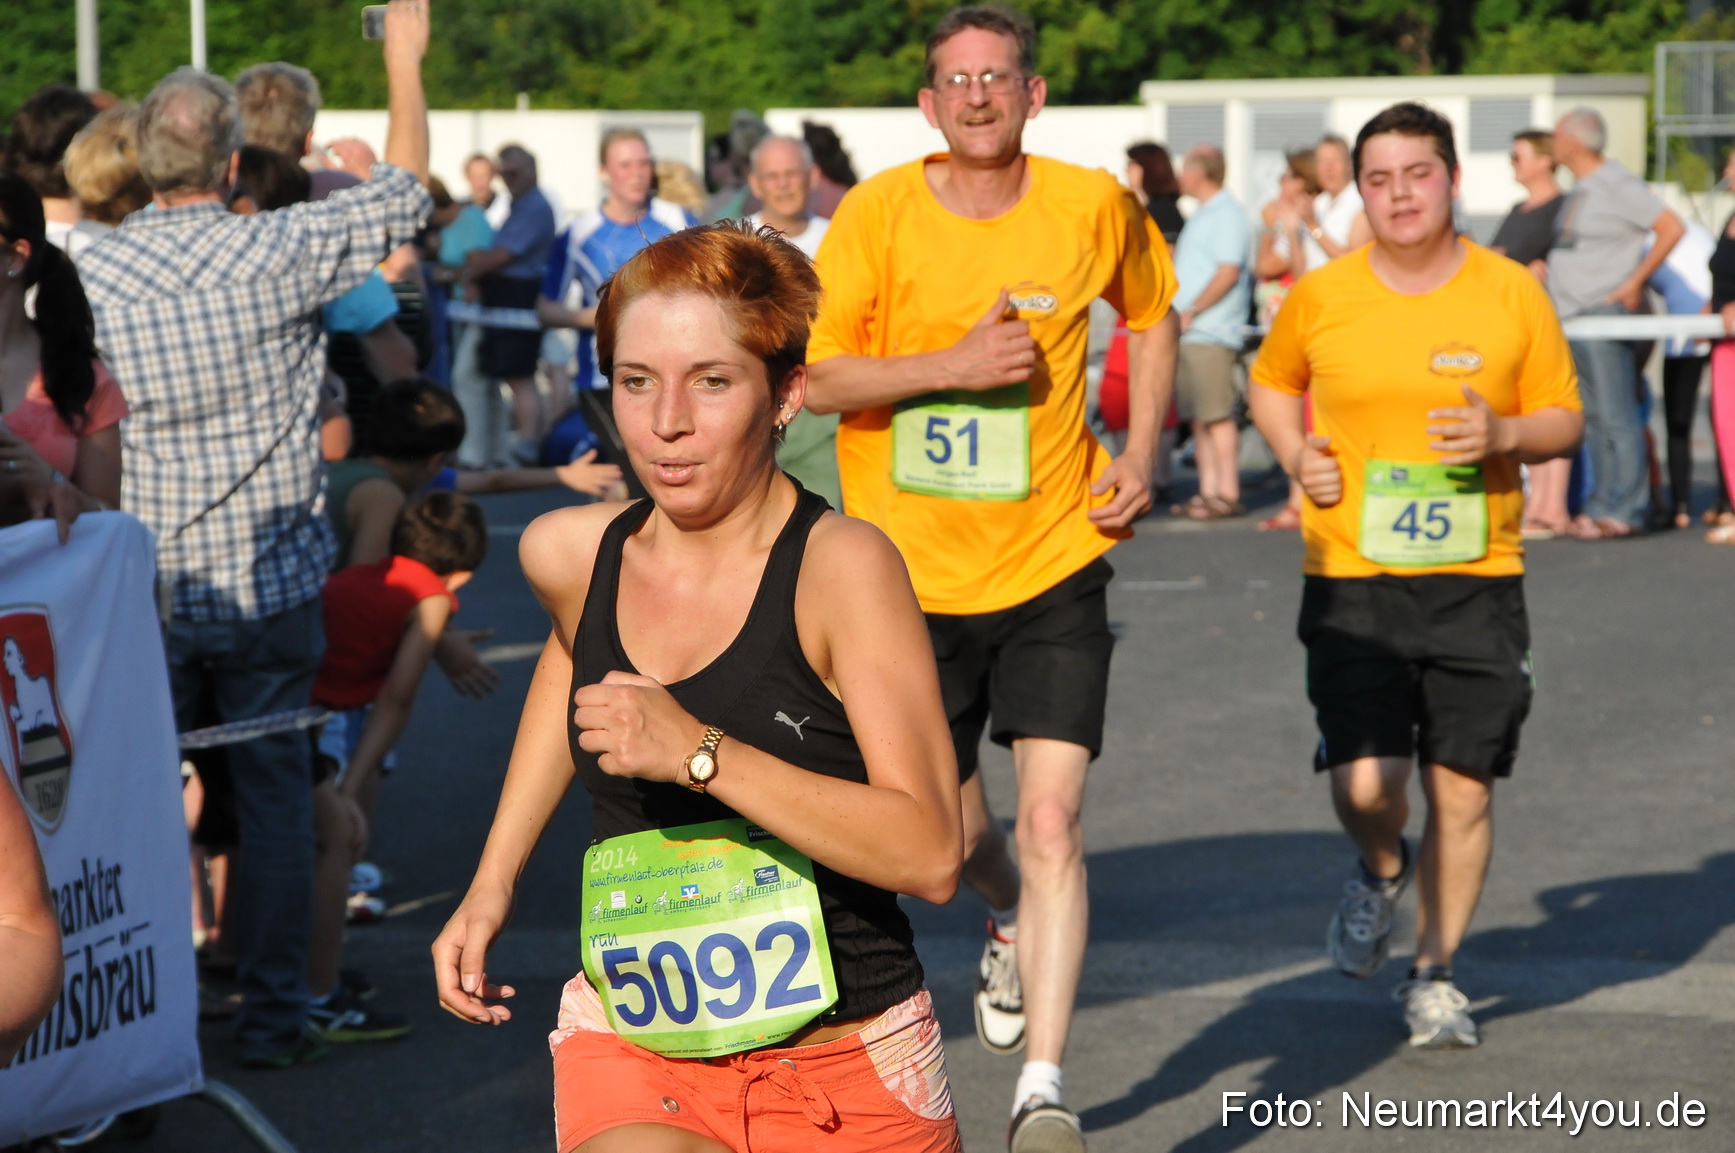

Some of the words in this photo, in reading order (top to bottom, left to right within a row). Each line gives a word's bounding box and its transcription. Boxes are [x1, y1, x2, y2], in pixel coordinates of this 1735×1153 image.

[925, 415, 978, 466] 51
[1392, 501, 1451, 541] 45
[588, 857, 724, 888] www.firmenlauf-oberpfalz.de
[590, 845, 638, 873] 2014
[669, 891, 721, 910] firmenlauf
[746, 876, 803, 898] firmenlauf
[602, 902, 648, 919] firmenlauf
[602, 920, 821, 1027] 5092
